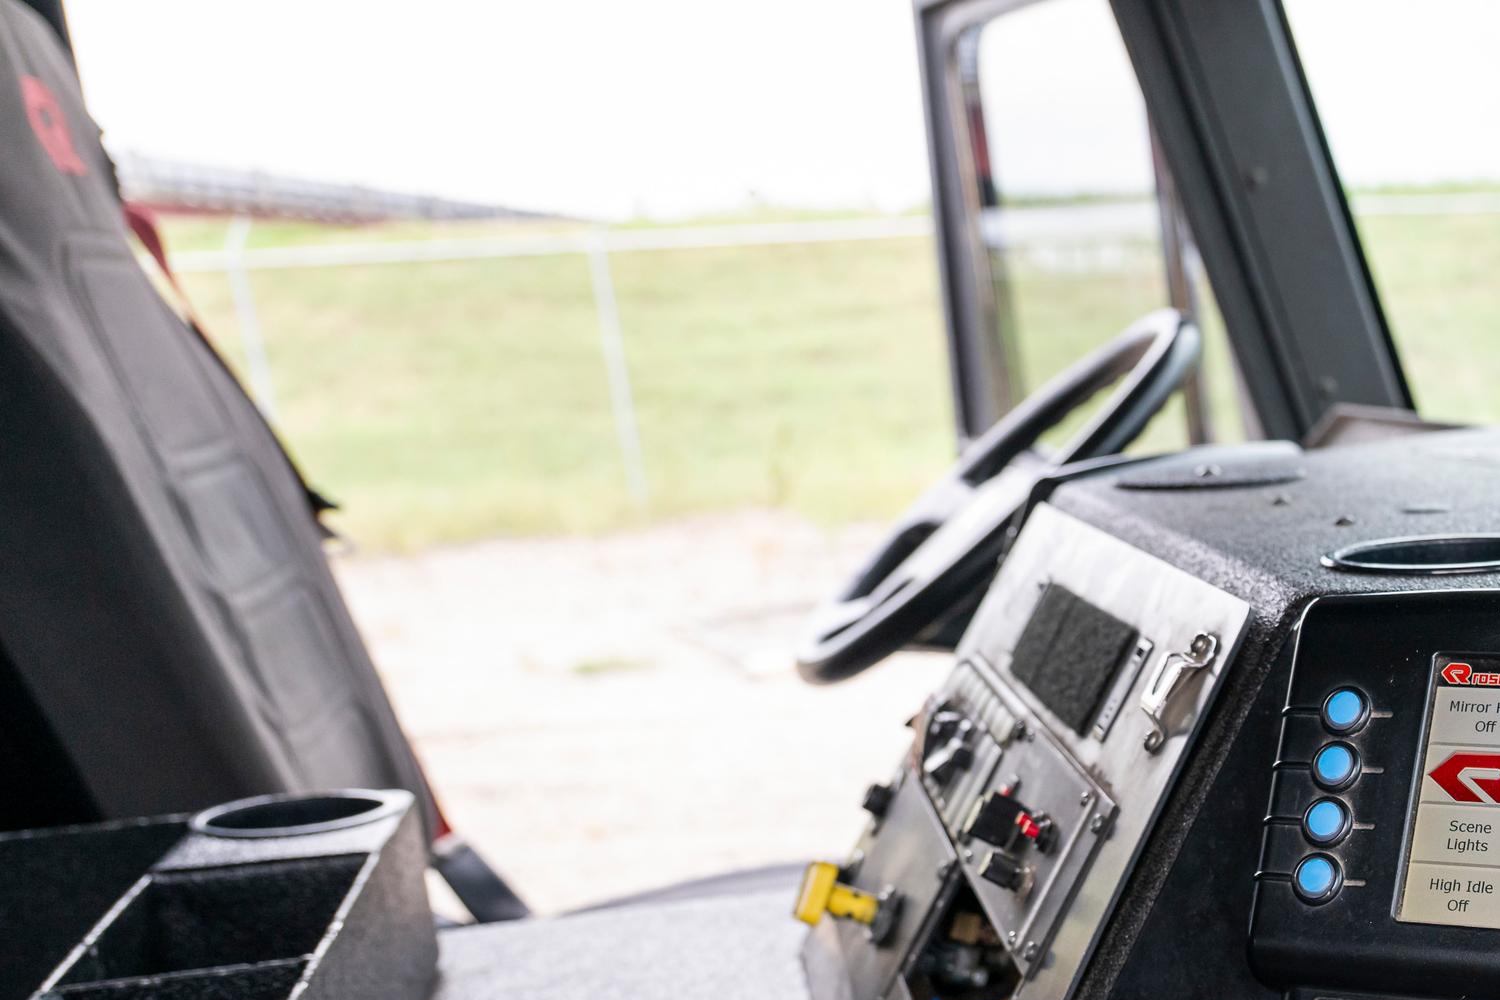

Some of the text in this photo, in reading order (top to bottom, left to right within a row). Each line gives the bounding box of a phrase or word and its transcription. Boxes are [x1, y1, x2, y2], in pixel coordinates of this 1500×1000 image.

[1450, 700, 1491, 713] Mirror
[1475, 720, 1497, 733] Off
[1449, 820, 1492, 834] Scene
[1446, 838, 1489, 853] Lights
[1429, 878, 1493, 893] High Idle
[1447, 899, 1470, 912] Off
